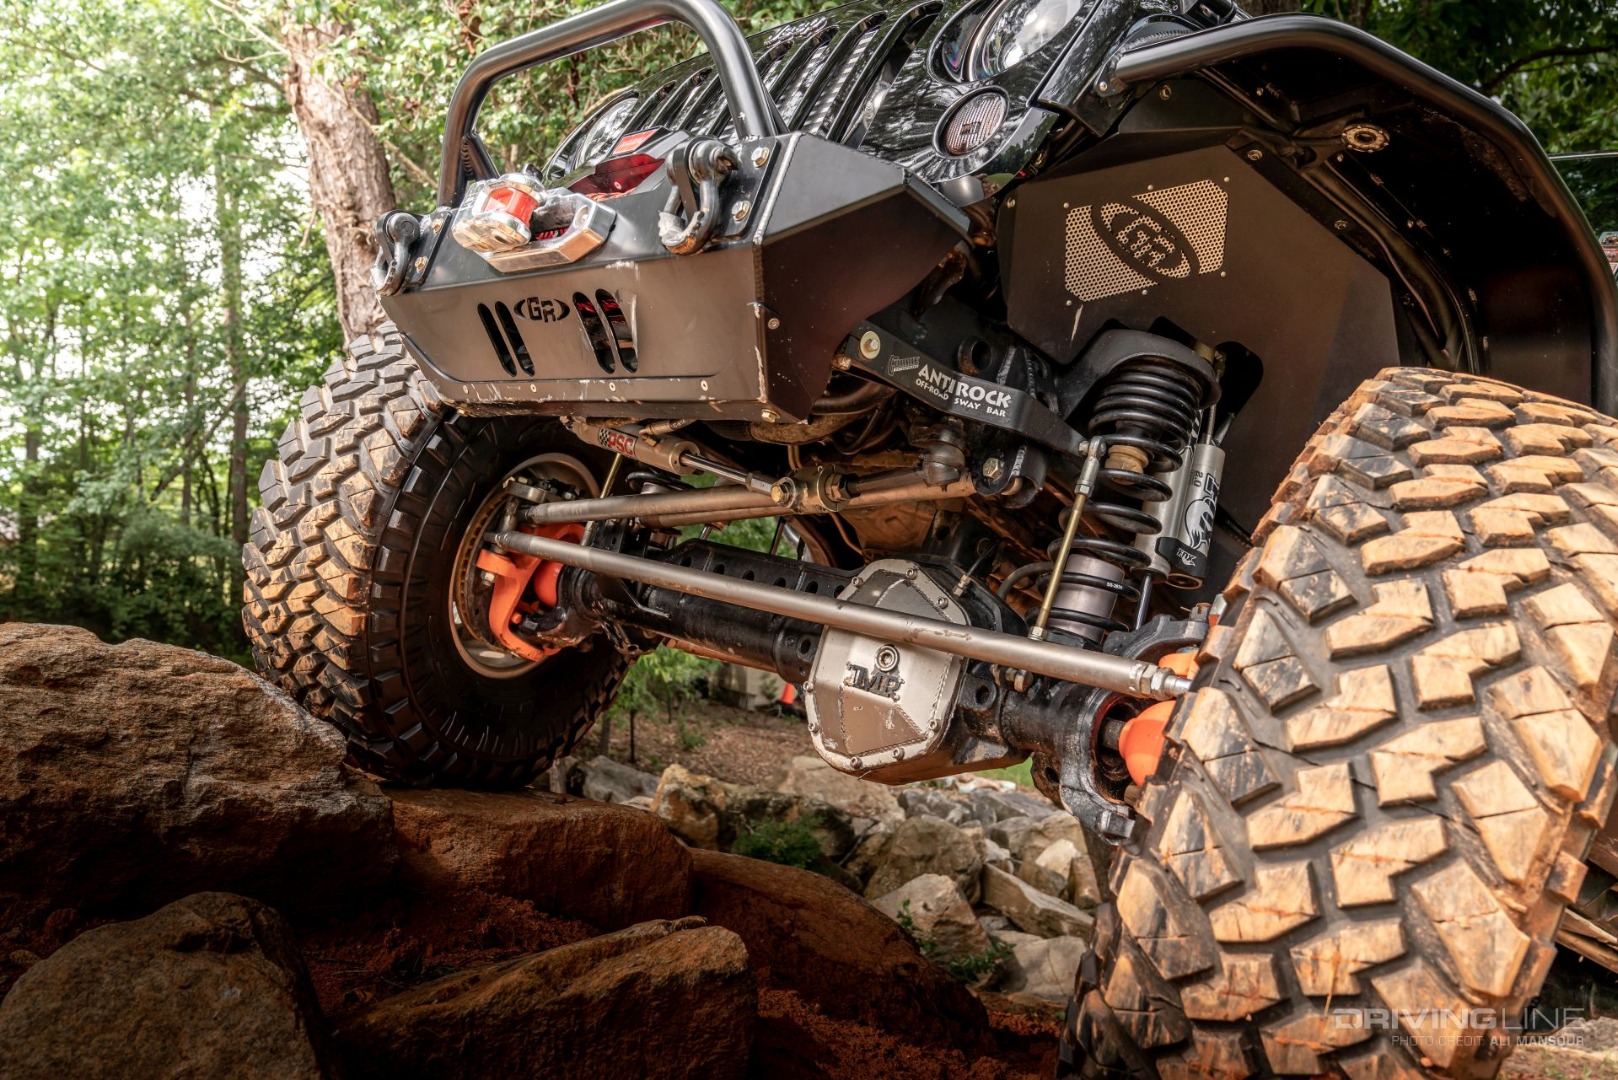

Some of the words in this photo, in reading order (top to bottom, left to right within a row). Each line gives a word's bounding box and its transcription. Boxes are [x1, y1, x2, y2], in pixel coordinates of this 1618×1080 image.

[915, 378, 949, 401] OFF-ROAD
[953, 397, 981, 410] SWAY
[986, 406, 1006, 417] BAR
[607, 431, 634, 457] PSC
